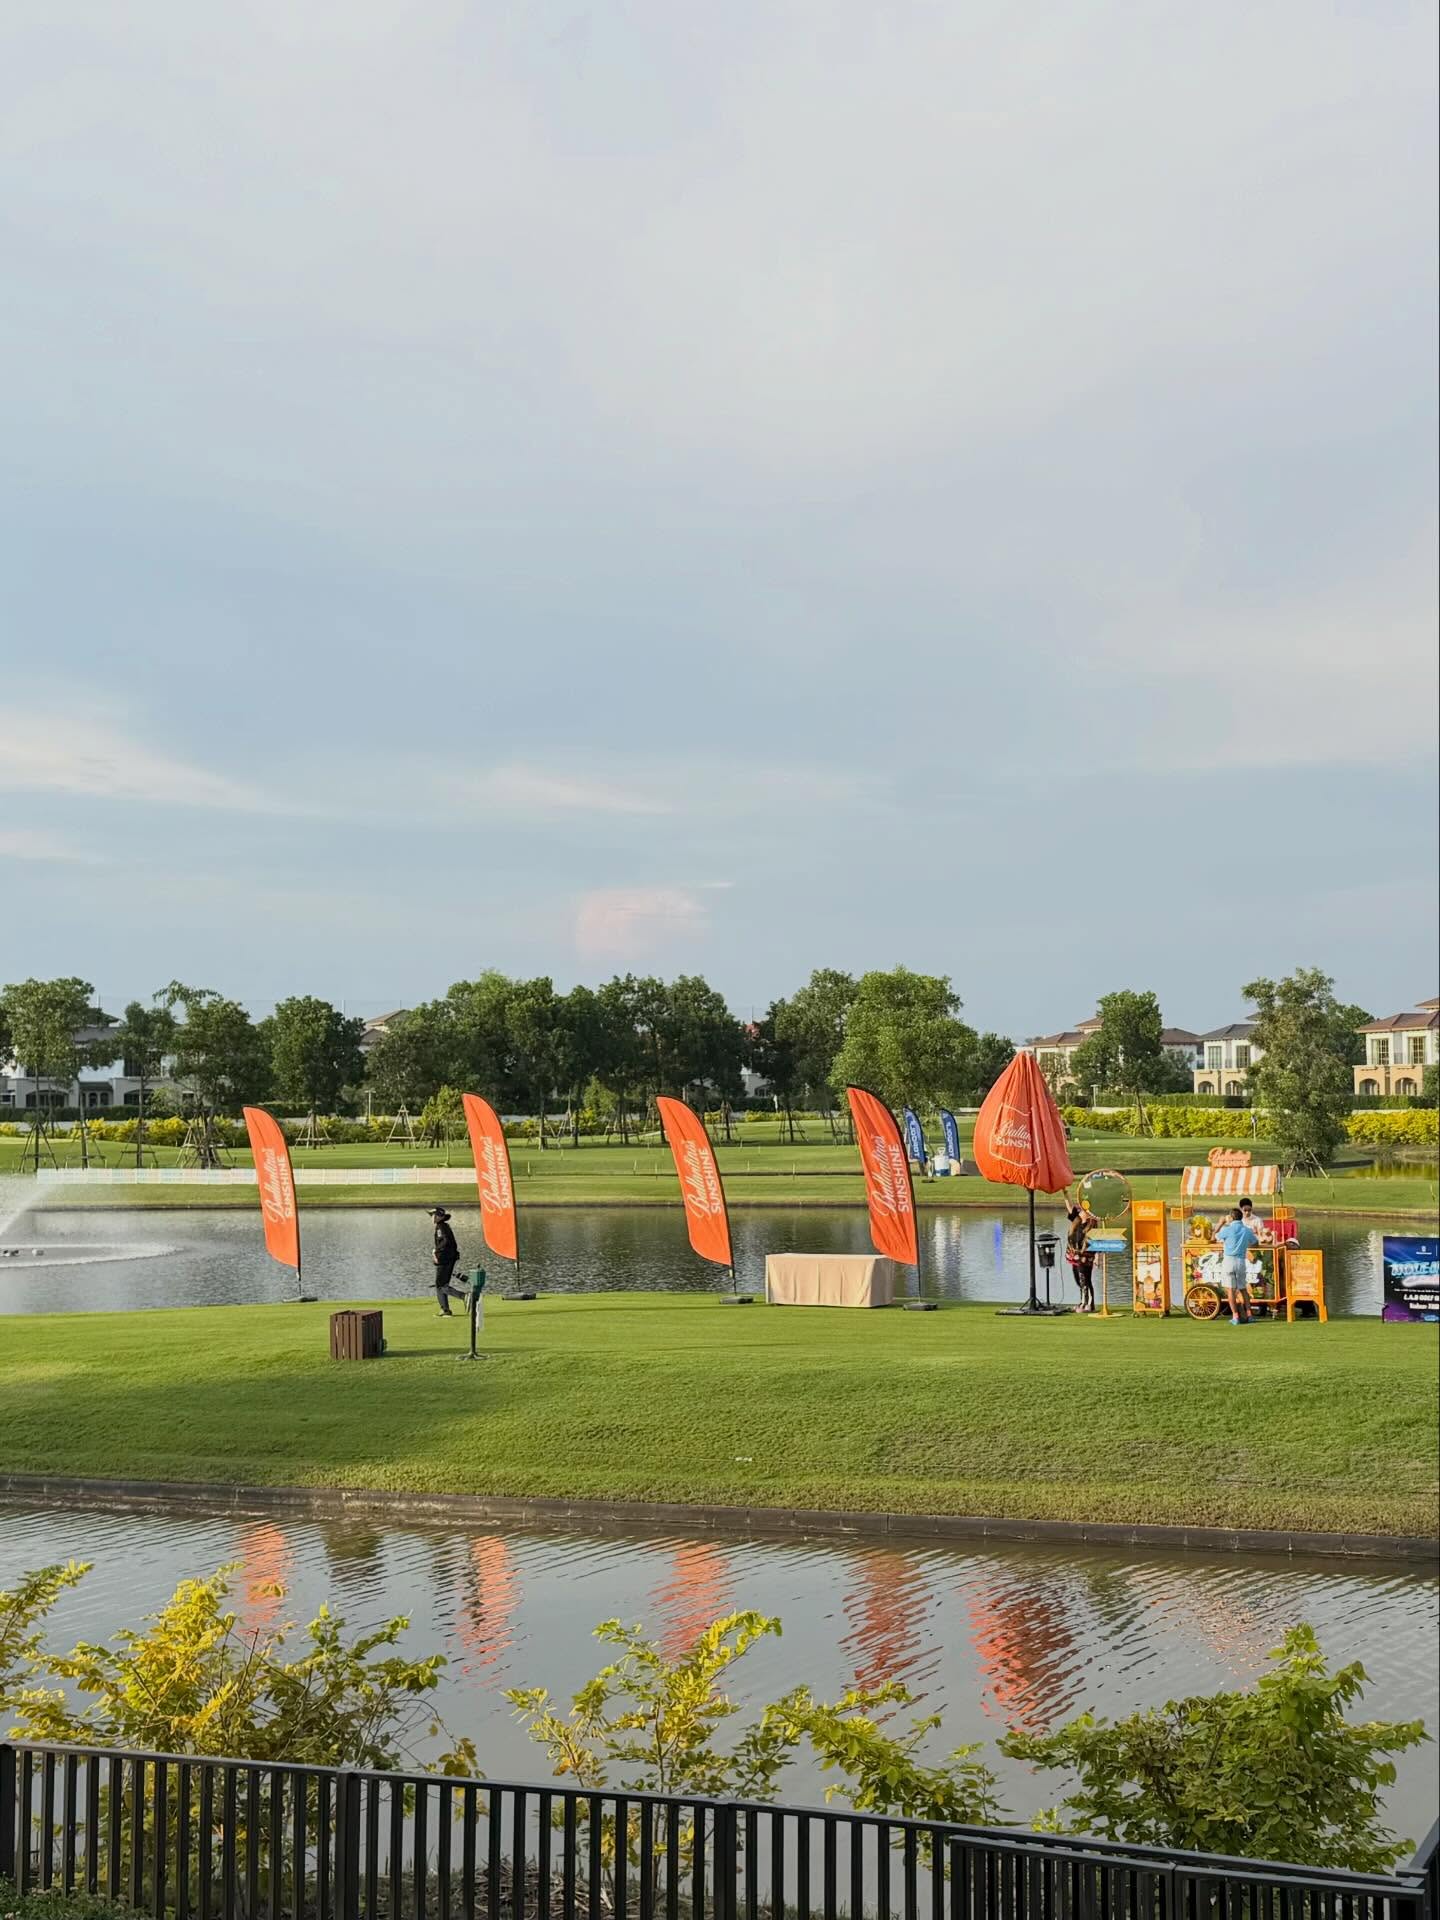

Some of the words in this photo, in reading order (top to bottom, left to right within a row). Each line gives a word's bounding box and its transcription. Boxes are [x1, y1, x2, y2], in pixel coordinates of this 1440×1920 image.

[276, 1153, 294, 1217] SUNSHINE
[496, 1144, 512, 1209] SUNSHINE
[698, 1148, 721, 1214] SUNSHINE
[888, 1143, 910, 1213] SUNSHINE
